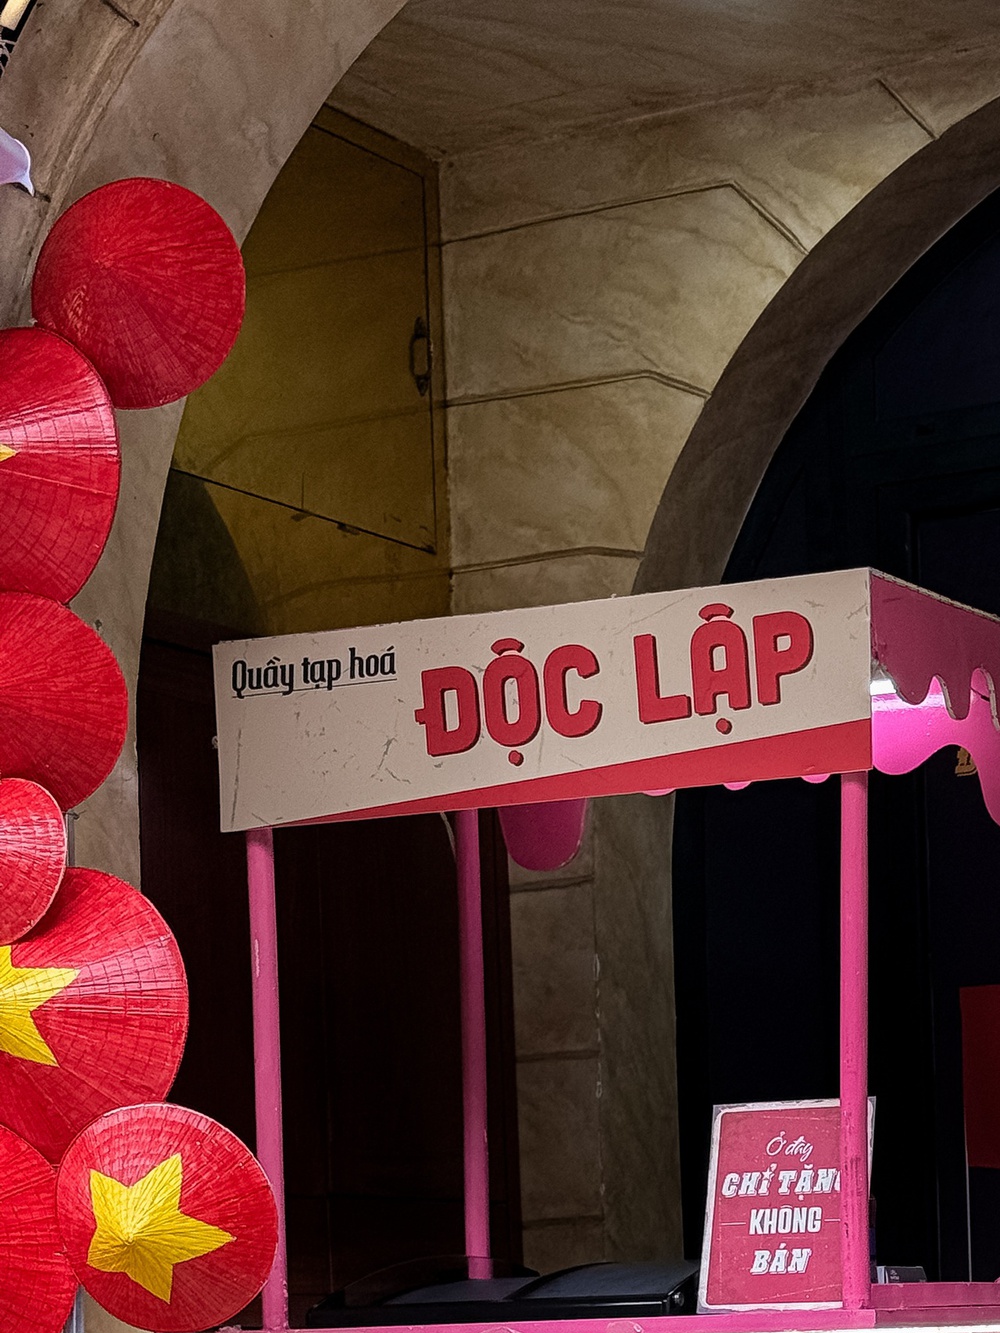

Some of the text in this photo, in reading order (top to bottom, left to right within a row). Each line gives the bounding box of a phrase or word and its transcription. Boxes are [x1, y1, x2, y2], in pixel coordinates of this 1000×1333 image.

[231, 645, 397, 699] Quầy tạp hoá
[415, 603, 814, 767] ĐỘC LẬP
[766, 1131, 814, 1162] Ở đây
[722, 1163, 841, 1201] CHỈ TẶN
[749, 1205, 822, 1235] KHÔNG
[750, 1243, 812, 1275] BÁN
